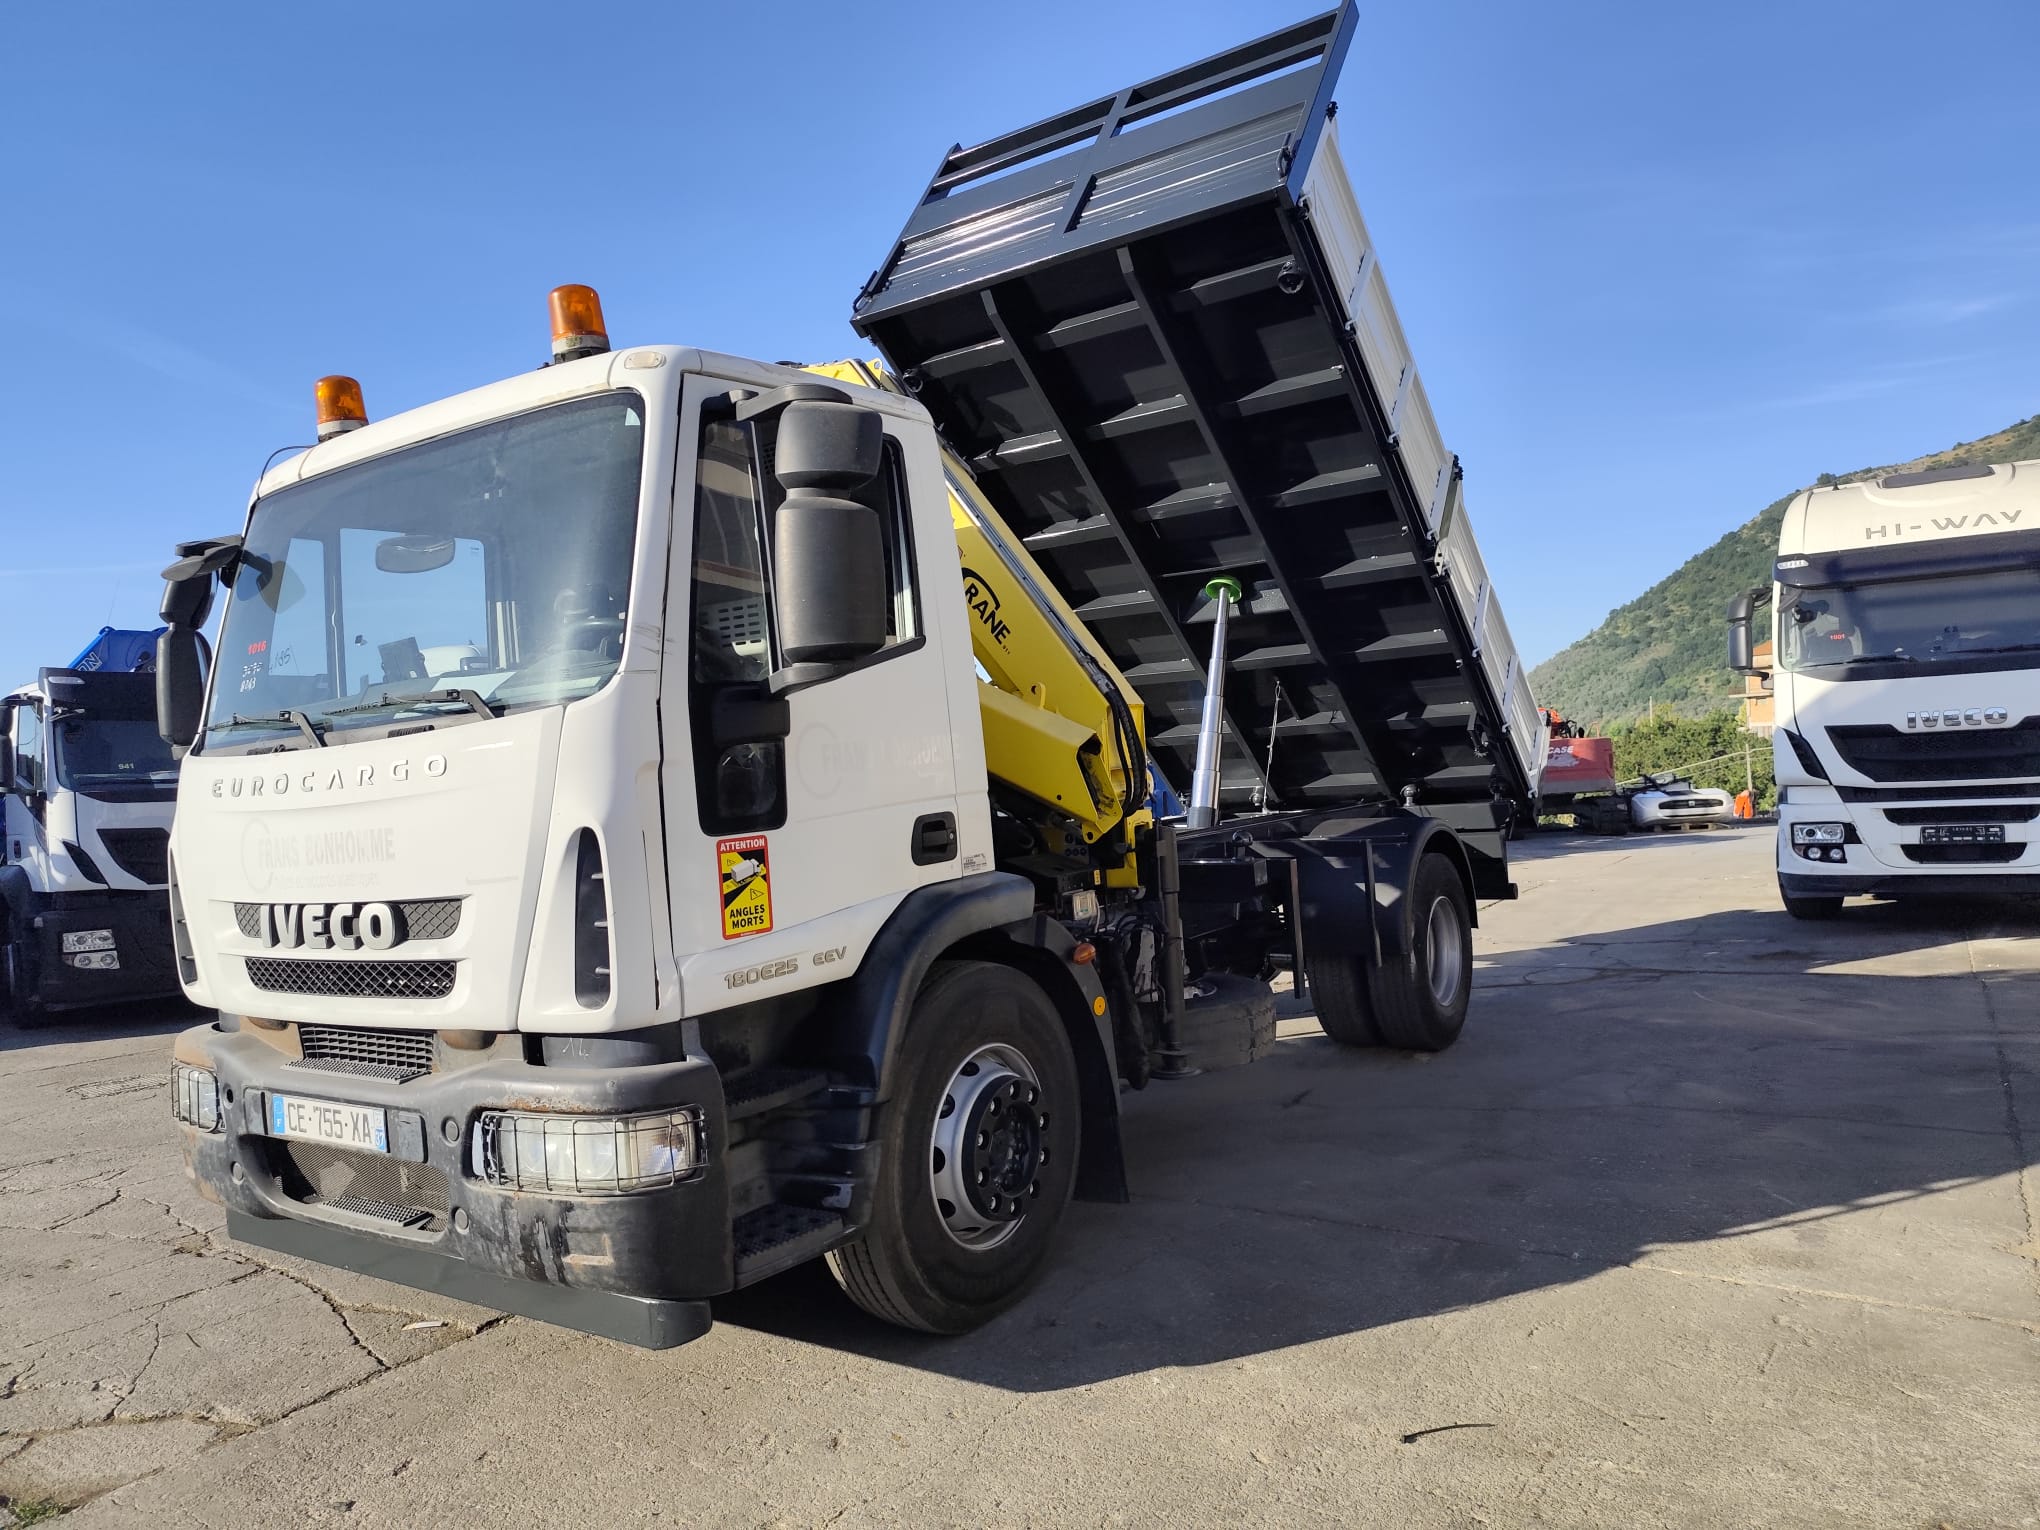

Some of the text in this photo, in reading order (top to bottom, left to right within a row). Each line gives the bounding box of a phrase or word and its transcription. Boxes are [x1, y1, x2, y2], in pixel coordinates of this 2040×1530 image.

[1865, 509, 2023, 540] HI-WAY
[1907, 706, 2008, 729] IVECO
[210, 753, 449, 798] EUROCARGO
[720, 838, 765, 852] ATTENTION
[729, 903, 766, 919] ANGLES
[731, 915, 765, 930] MORTS
[260, 902, 397, 950] IVECO
[723, 945, 848, 990] 180E25 EEV
